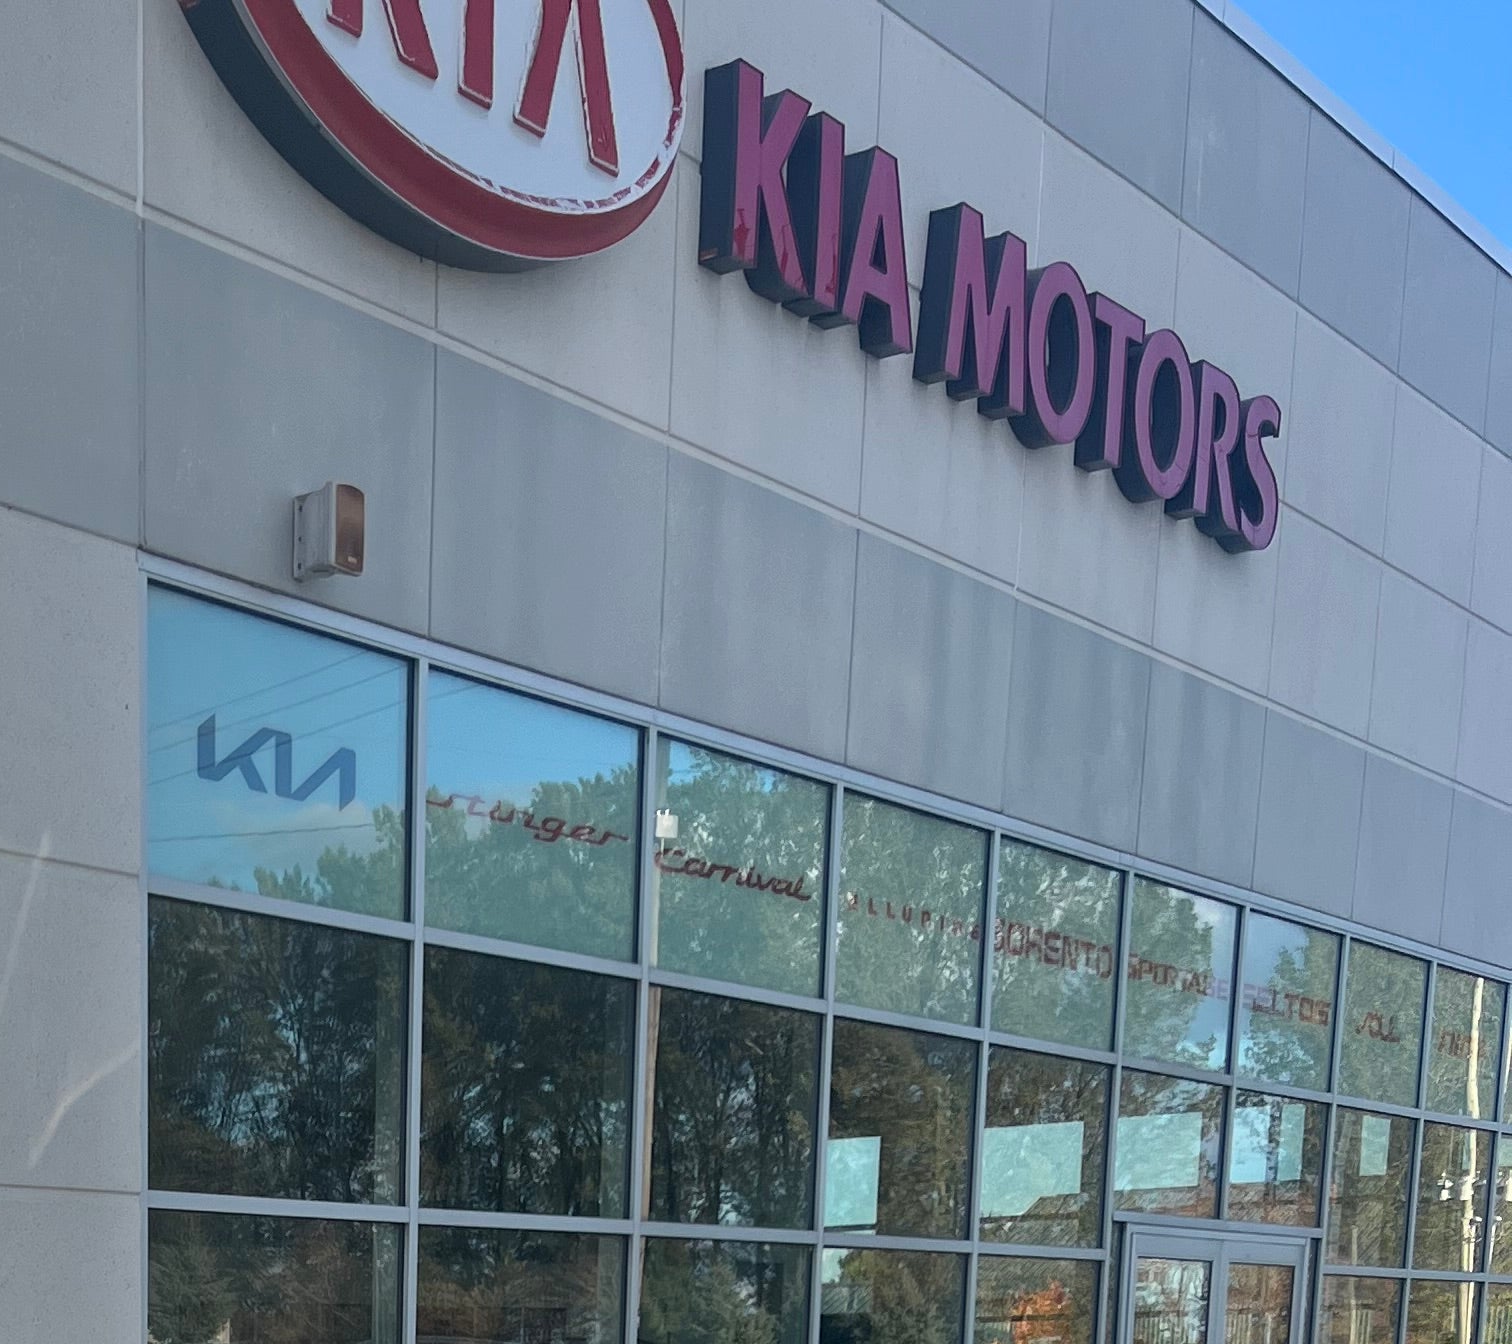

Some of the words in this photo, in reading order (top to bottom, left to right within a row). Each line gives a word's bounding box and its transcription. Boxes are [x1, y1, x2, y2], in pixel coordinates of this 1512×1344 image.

[728, 57, 914, 354] KIA
[944, 202, 1281, 553] MOTORS
[197, 713, 358, 811] KIA
